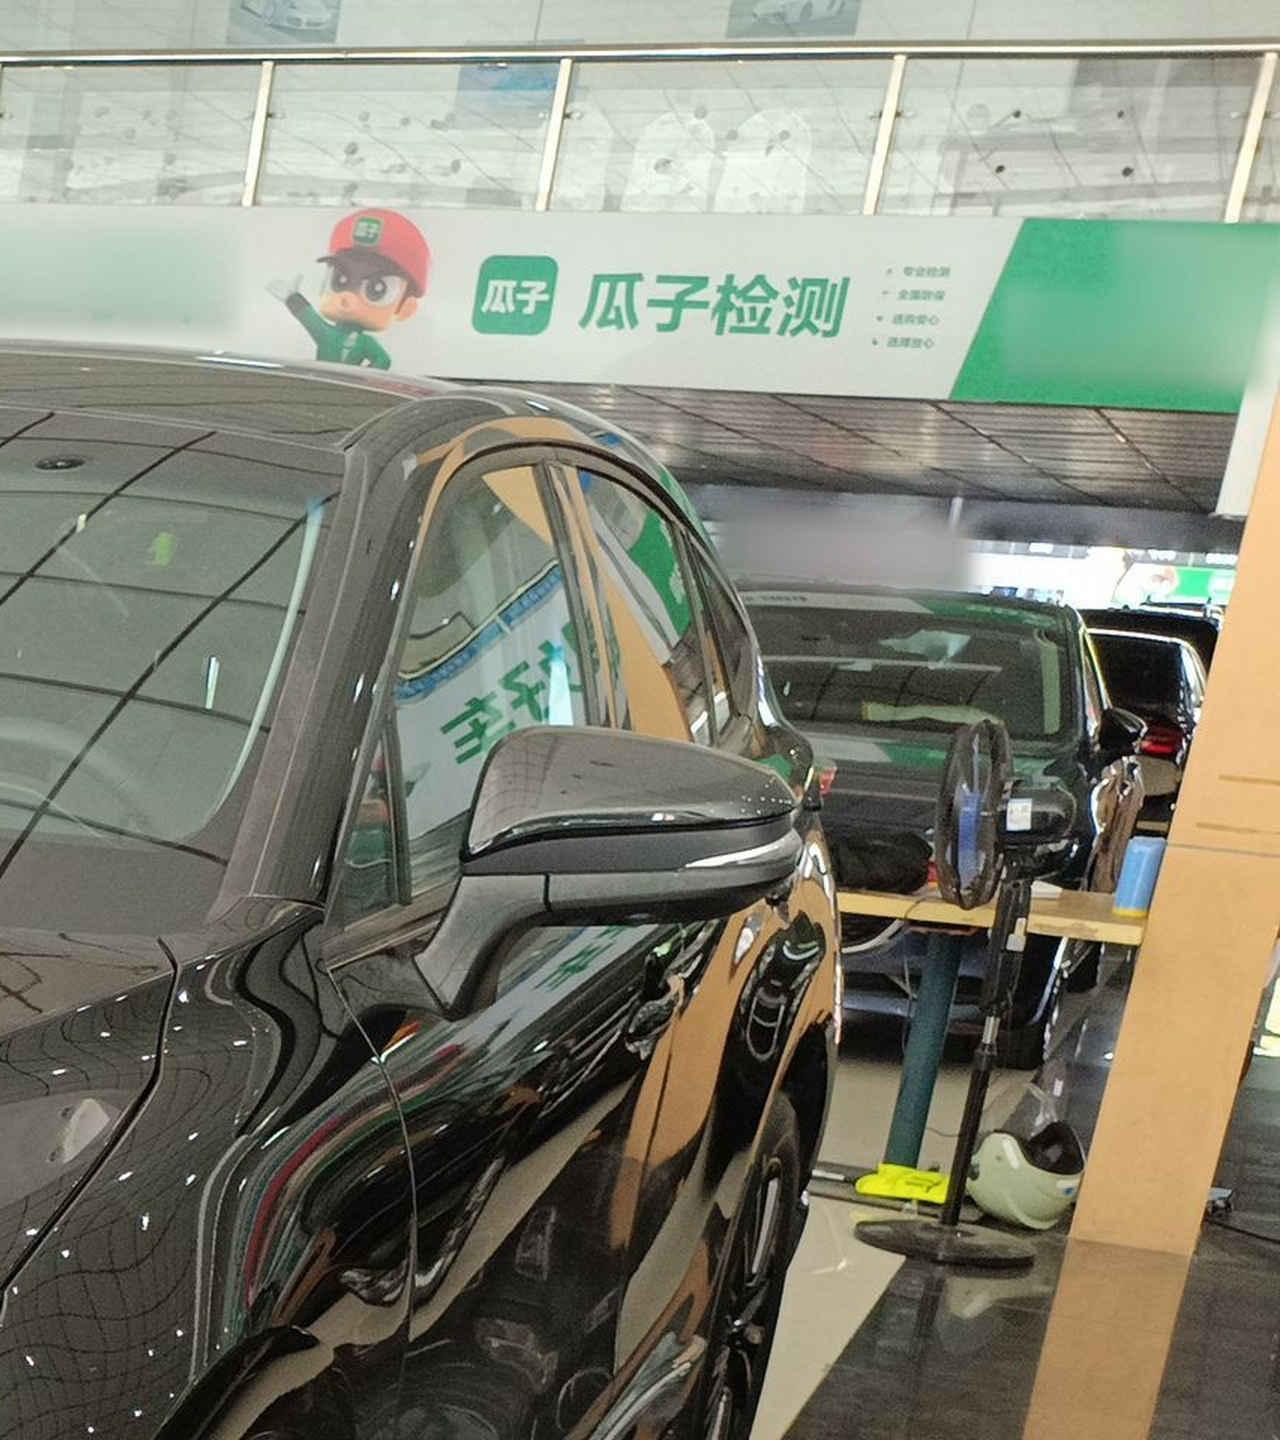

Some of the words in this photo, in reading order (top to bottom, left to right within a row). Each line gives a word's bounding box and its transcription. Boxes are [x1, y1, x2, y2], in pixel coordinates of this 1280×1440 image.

[481, 279, 549, 315] 瓜子
[578, 273, 851, 338] 瓜子检测
